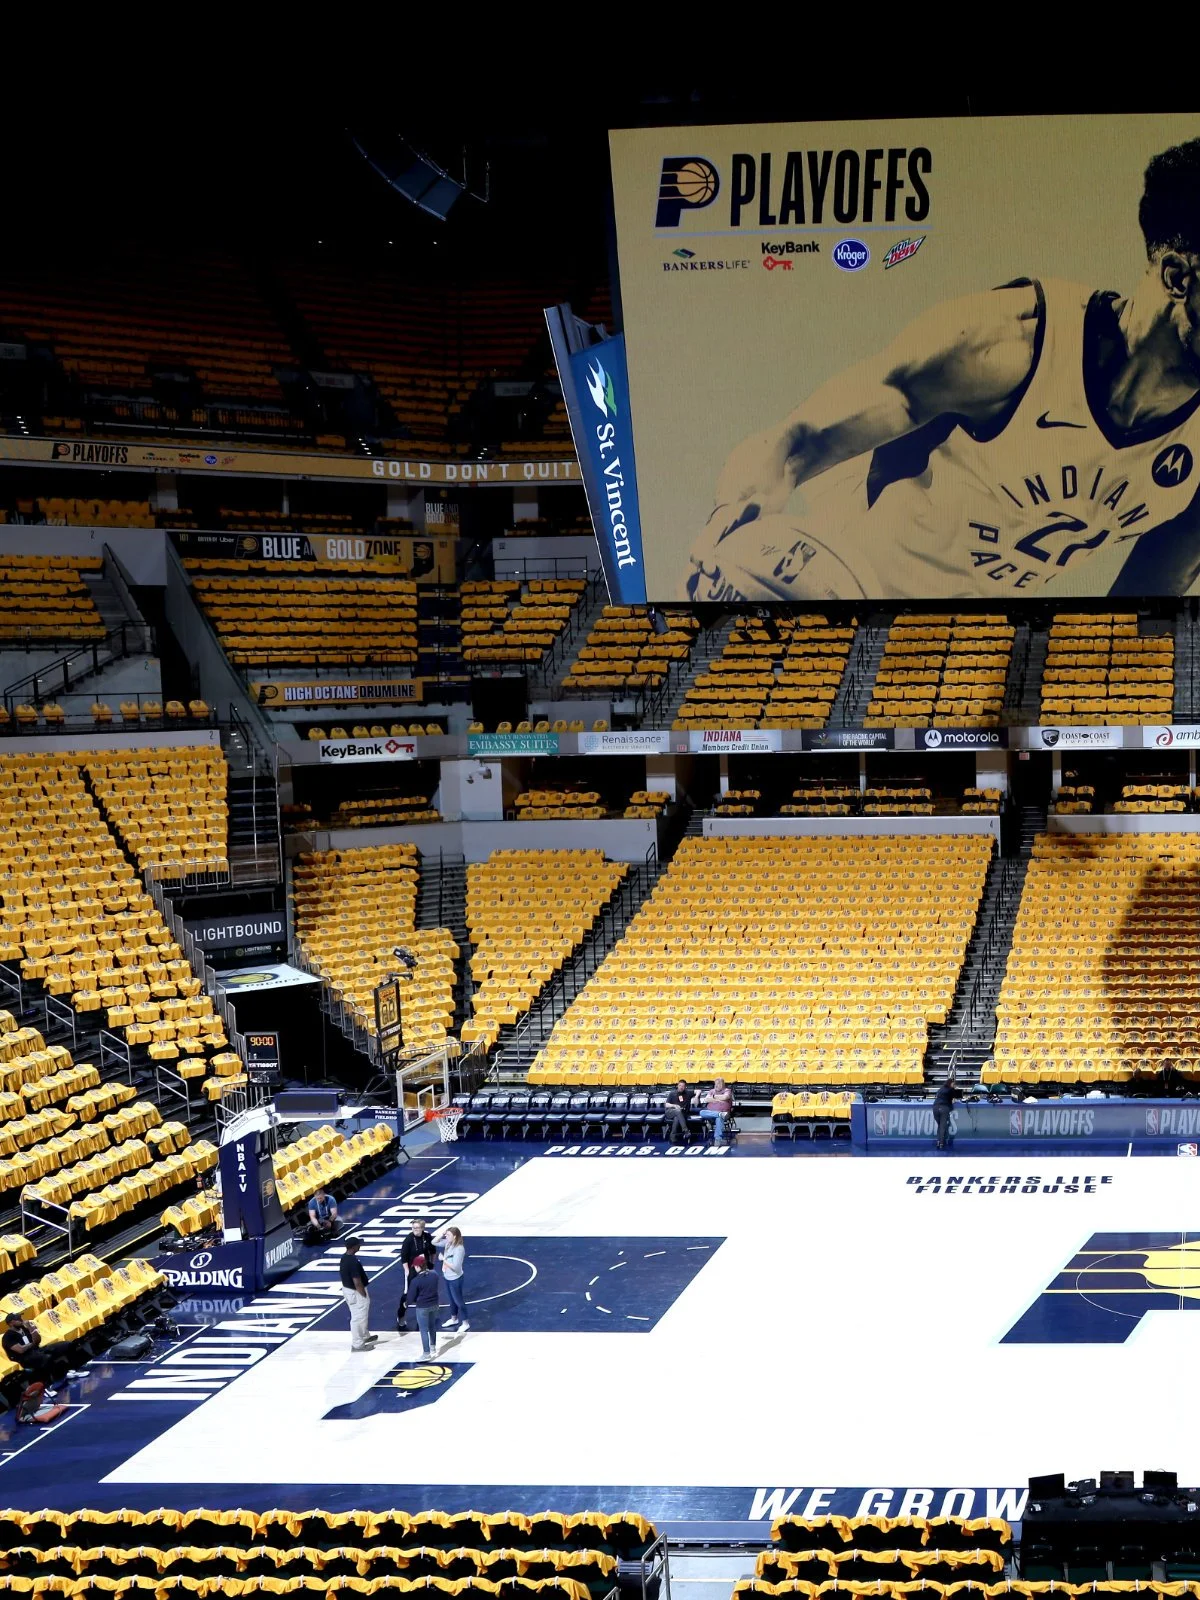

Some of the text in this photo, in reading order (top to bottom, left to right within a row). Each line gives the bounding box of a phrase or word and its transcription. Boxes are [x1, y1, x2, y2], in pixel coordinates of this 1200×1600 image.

[730, 147, 932, 226] PLAYOFFS
[761, 241, 820, 255] KeyBank
[837, 244, 866, 267] Kroger
[663, 260, 749, 271] BANKERS LIFE
[72, 443, 129, 464] PLAYOFFS
[372, 461, 432, 478] GOLD
[523, 462, 573, 478] QUIT
[597, 422, 637, 568] St. Vincent
[425, 503, 444, 513] BLUE
[262, 537, 301, 559] BLUE
[326, 538, 366, 559] GOLD
[284, 684, 415, 700] HIGH OCTANE DRUMLINE
[602, 735, 662, 745] Renaissance
[703, 730, 742, 742] INDIANA
[944, 731, 999, 743] motorola
[1061, 732, 1081, 740] COAST
[1089, 732, 1110, 740] COAST
[321, 744, 383, 758] KeyBank
[469, 740, 559, 750] EMBASSY SUITES
[702, 743, 769, 751] Members Credit Union
[194, 921, 282, 942] LIGHTBOUND
[250, 1036, 274, 1046] 90:00
[888, 1109, 959, 1136] PLAYOS
[1023, 1109, 1095, 1136] PLAYOFFS
[544, 1145, 732, 1156] PACERS.COM
[237, 1143, 247, 1194] NBA TV
[906, 1175, 1115, 1185] BANKERS LIFE
[914, 1184, 1099, 1195] FIELDHOUSE
[158, 1266, 245, 1289] SPALDING
[107, 1280, 343, 1401] INDIANA
[748, 1488, 849, 1521] WE
[856, 1487, 1030, 1521] GROW
